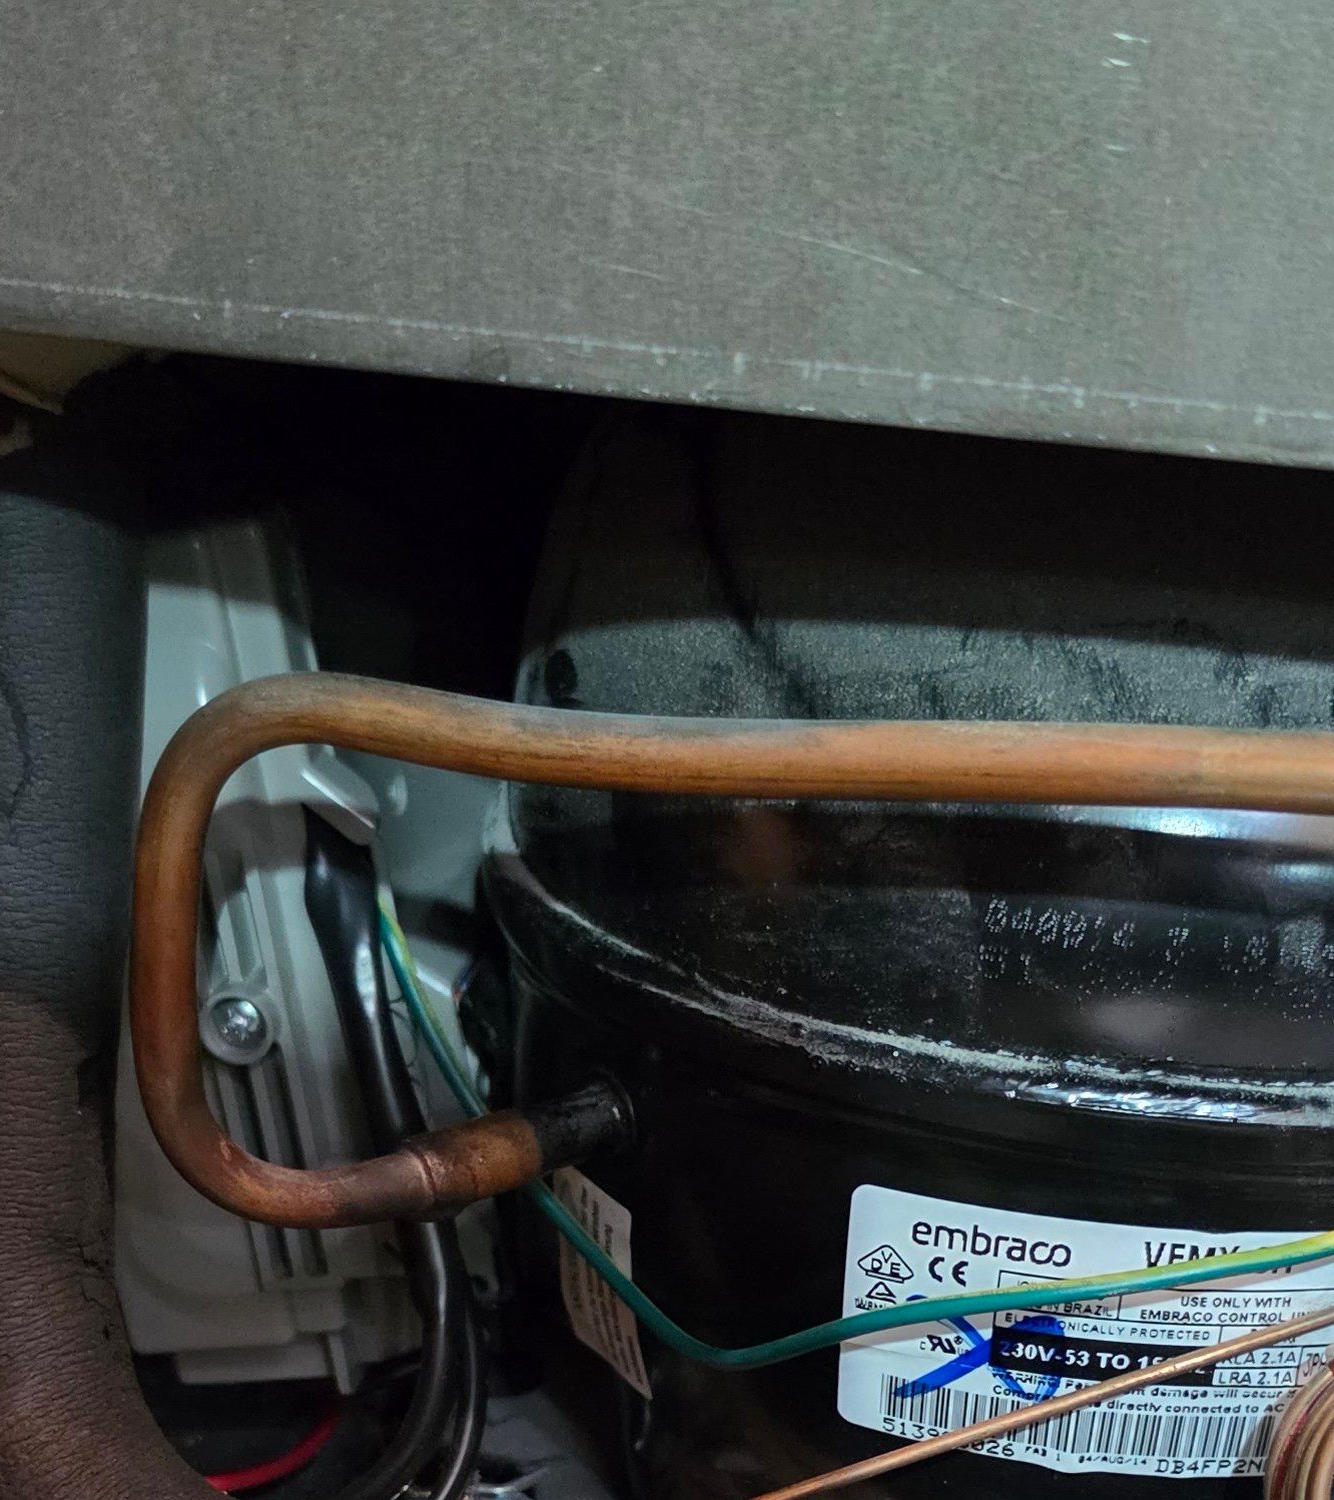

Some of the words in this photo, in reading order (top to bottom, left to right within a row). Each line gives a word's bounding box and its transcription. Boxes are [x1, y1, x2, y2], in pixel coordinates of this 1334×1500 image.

[912, 1221, 1072, 1267] embraco
[1181, 1296, 1206, 1308] USE
[1213, 1297, 1250, 1309] ONLY
[1255, 1297, 1291, 1308] WITH
[1064, 1302, 1114, 1318] BRAZIL
[1140, 1309, 1213, 1323] EMBRACO
[1218, 1310, 1284, 1323] CONTROL
[1130, 1327, 1210, 1341] PROTECTED
[1096, 1352, 1130, 1370] TO
[1261, 1352, 1296, 1364] 2.1A
[1218, 1372, 1251, 1384] LRA
[1257, 1372, 1292, 1384] 2.1A
[1107, 1400, 1161, 1412] directly
[1165, 1404, 1241, 1414] connected
[1246, 1405, 1259, 1414] to
[1264, 1404, 1285, 1413] AC
[1154, 1457, 1267, 1475] DB4FP2N
